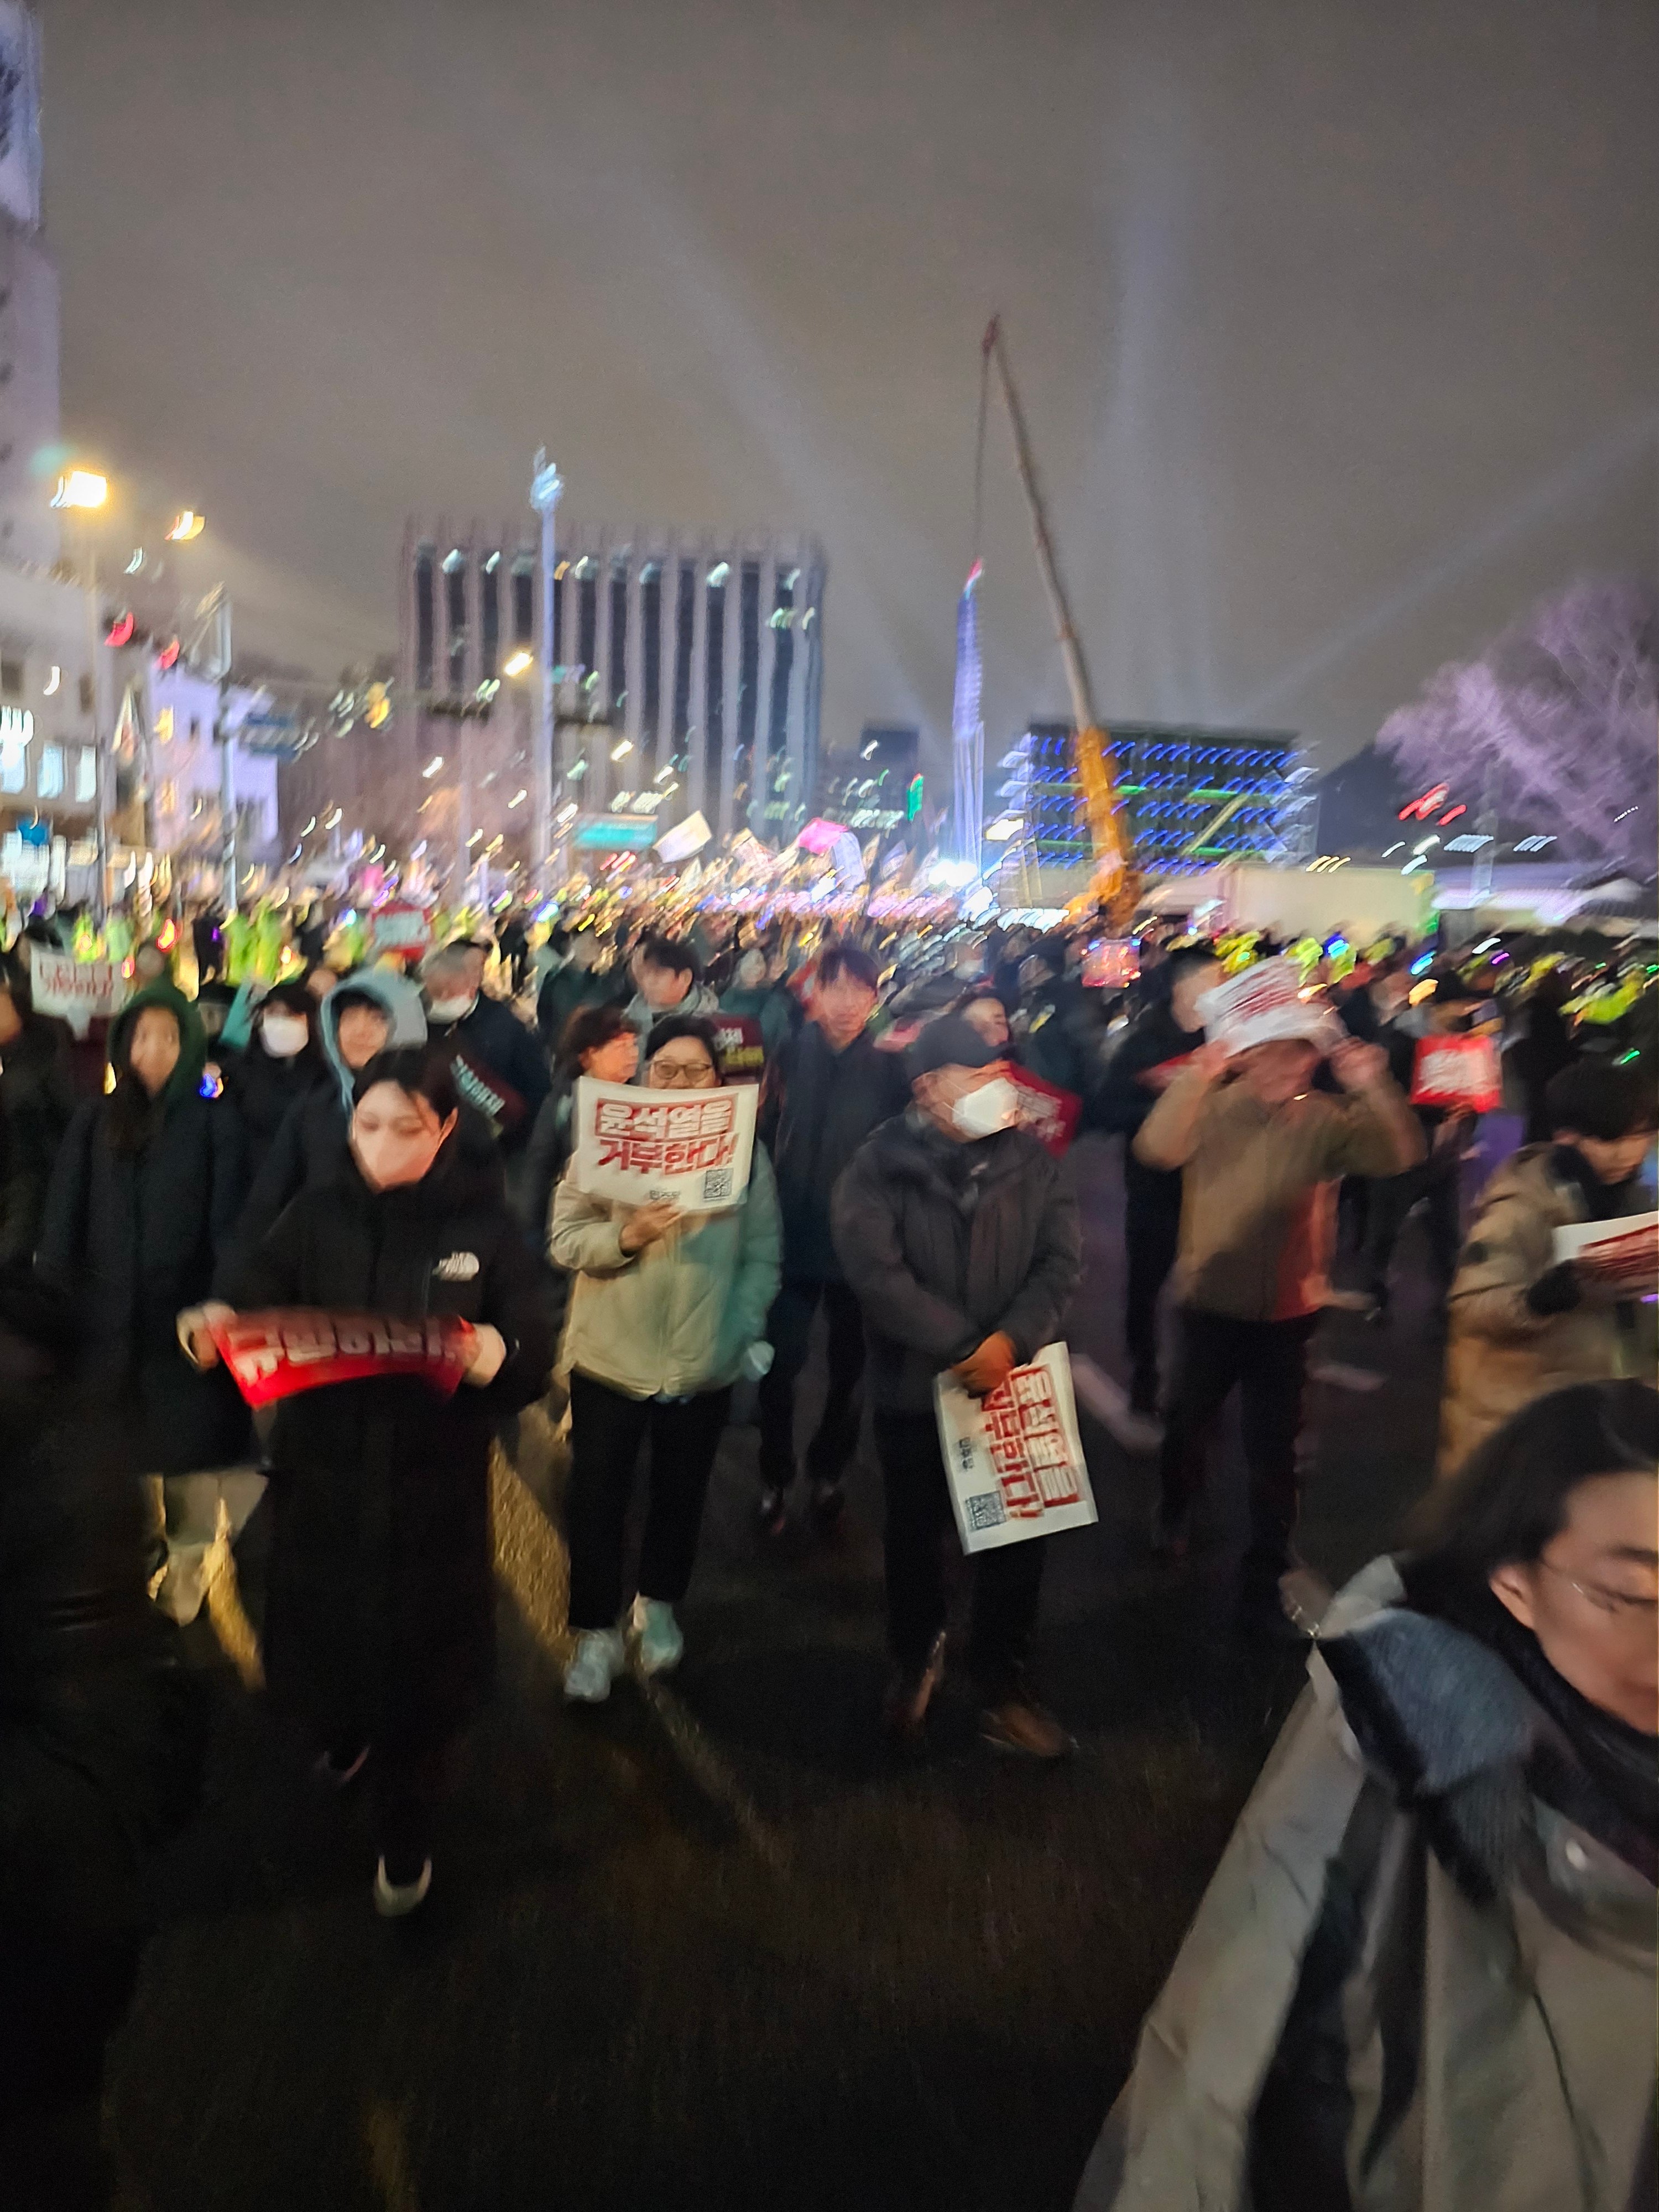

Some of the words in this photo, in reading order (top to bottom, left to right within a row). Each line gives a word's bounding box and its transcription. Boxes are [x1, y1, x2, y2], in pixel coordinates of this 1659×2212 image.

[599, 1100, 732, 1139] 윤석열을
[598, 1133, 739, 1175] 거부한다!
[1014, 1370, 1077, 1501] 윤석열을
